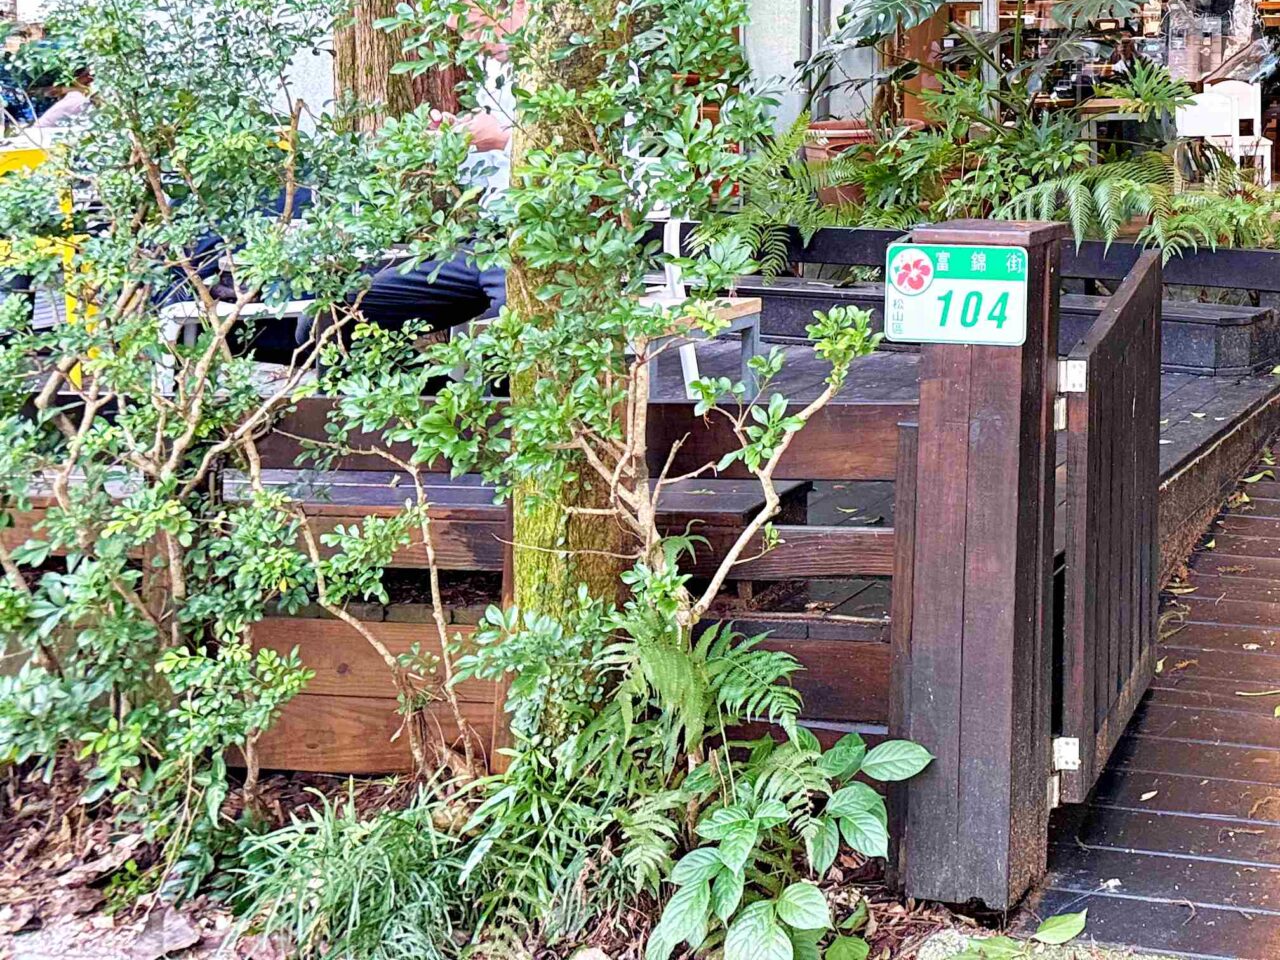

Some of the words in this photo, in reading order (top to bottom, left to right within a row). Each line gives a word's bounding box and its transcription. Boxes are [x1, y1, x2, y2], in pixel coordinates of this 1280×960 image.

[935, 251, 1023, 273] 富錦街
[937, 290, 1009, 329] 104
